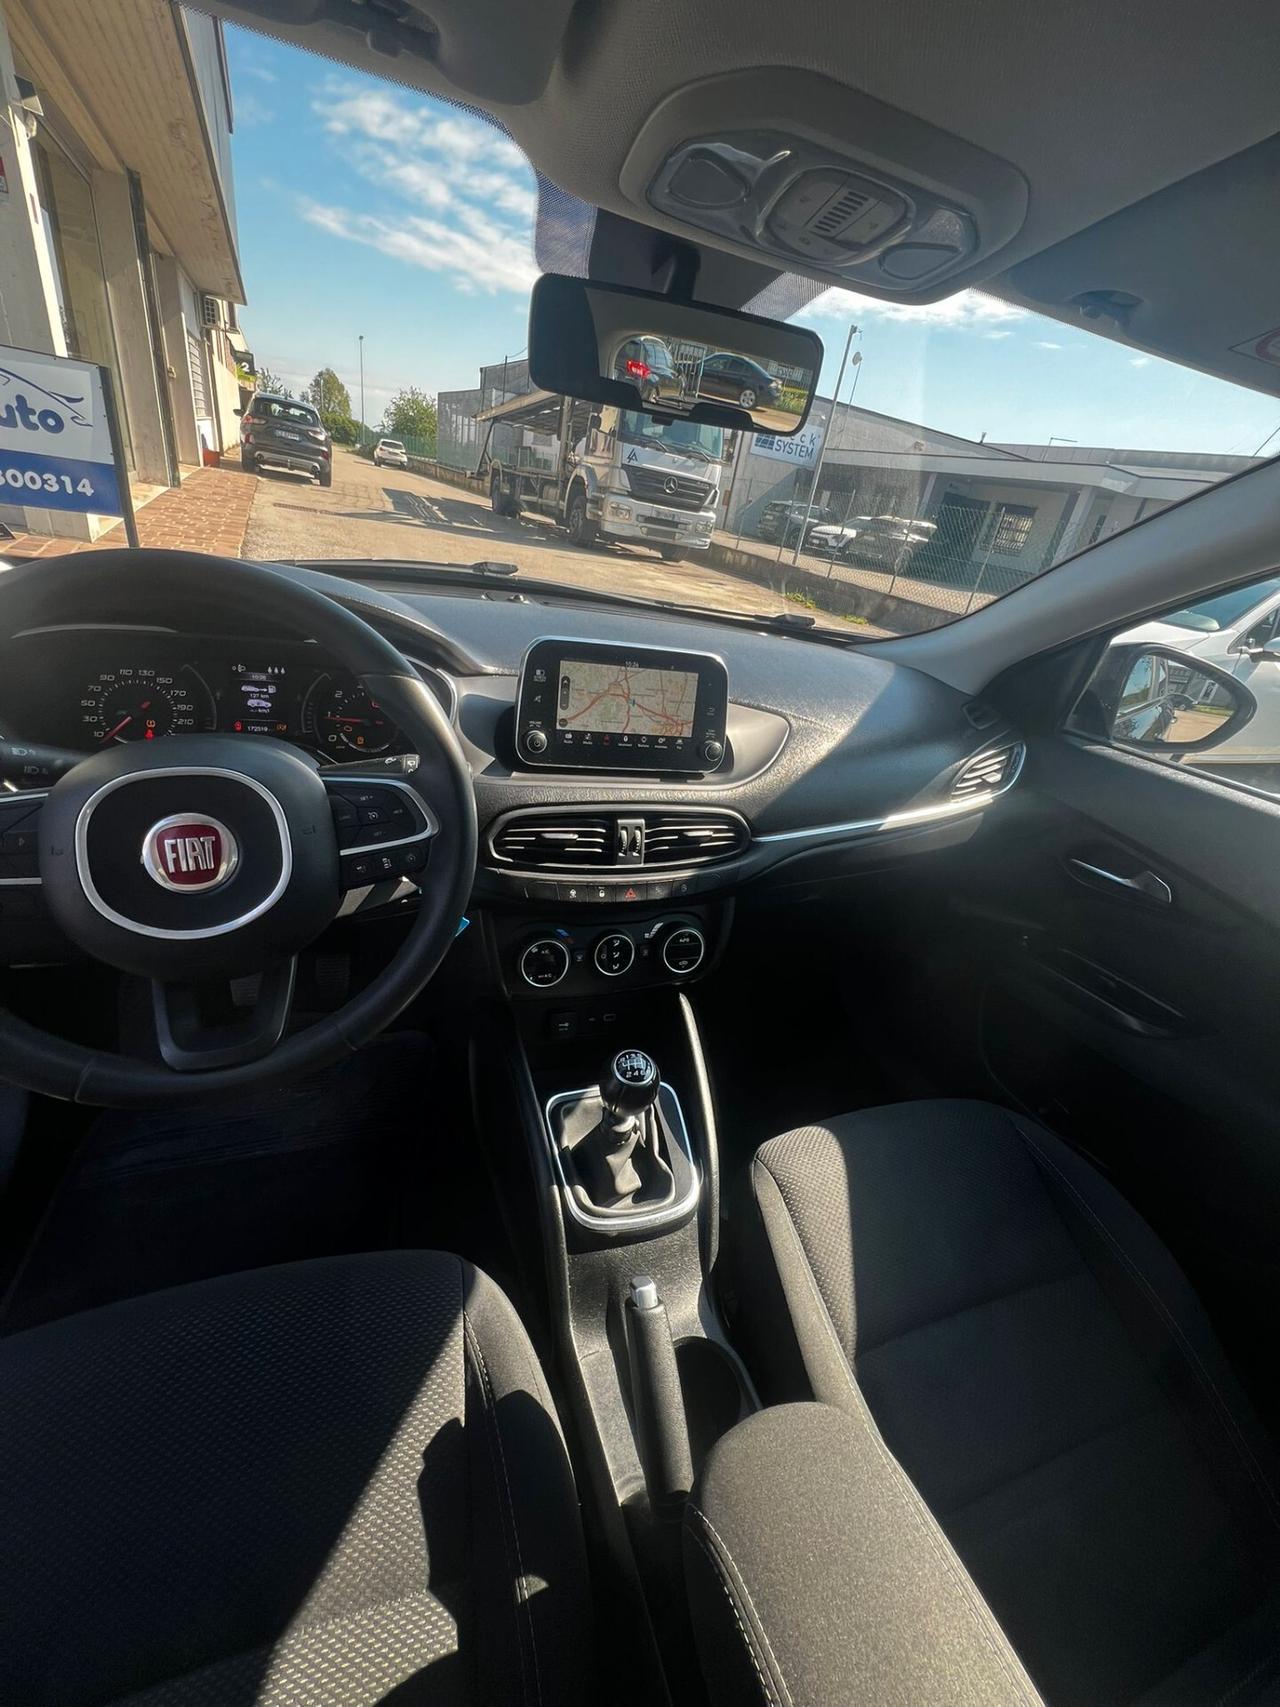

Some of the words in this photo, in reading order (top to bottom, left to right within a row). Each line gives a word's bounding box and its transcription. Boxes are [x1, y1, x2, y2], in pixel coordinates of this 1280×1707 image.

[775, 440, 814, 459] SYSTEM
[335, 690, 343, 698] 2
[164, 836, 216, 873] FIAT
